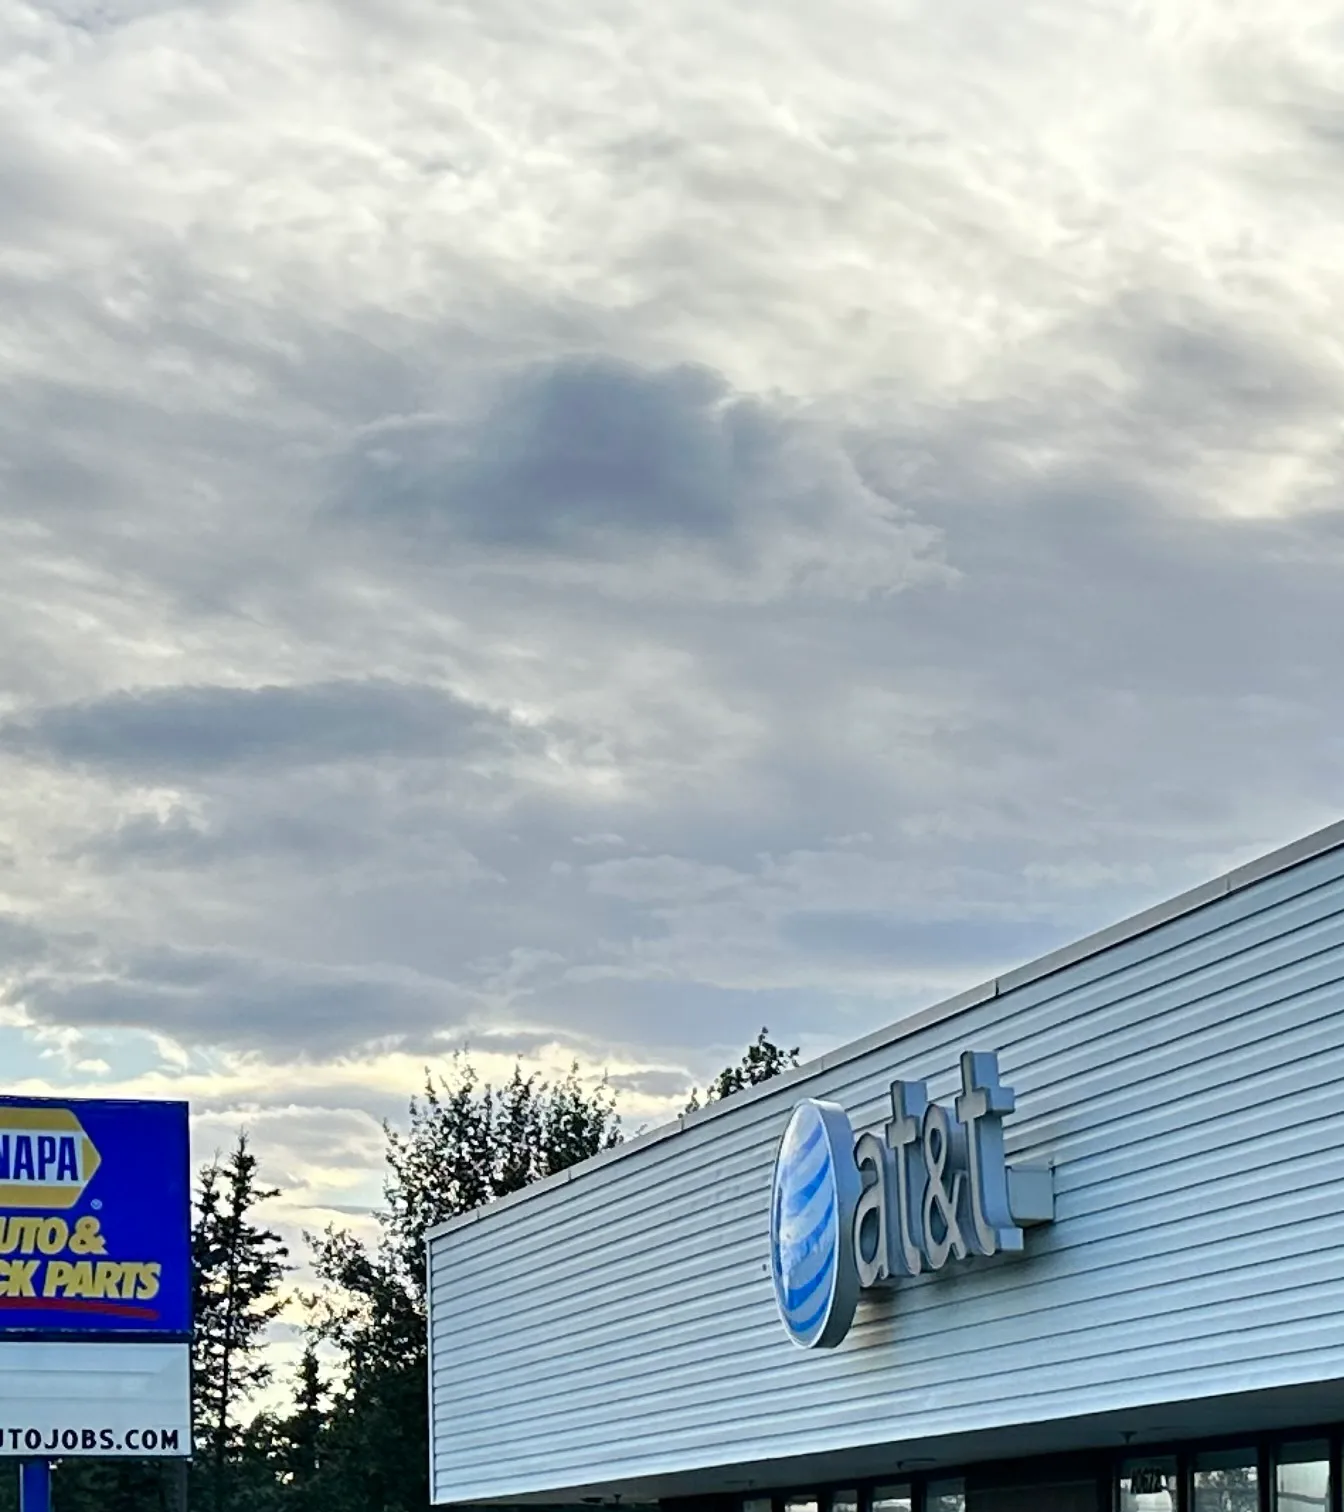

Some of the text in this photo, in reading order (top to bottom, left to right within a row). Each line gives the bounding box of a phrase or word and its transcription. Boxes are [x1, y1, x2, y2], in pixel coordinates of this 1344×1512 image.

[853, 1050, 1014, 1288] at&t
[69, 1216, 108, 1255] &
[42, 1261, 161, 1300] PARTS
[0, 1428, 179, 1450] TOJOBS.COM
